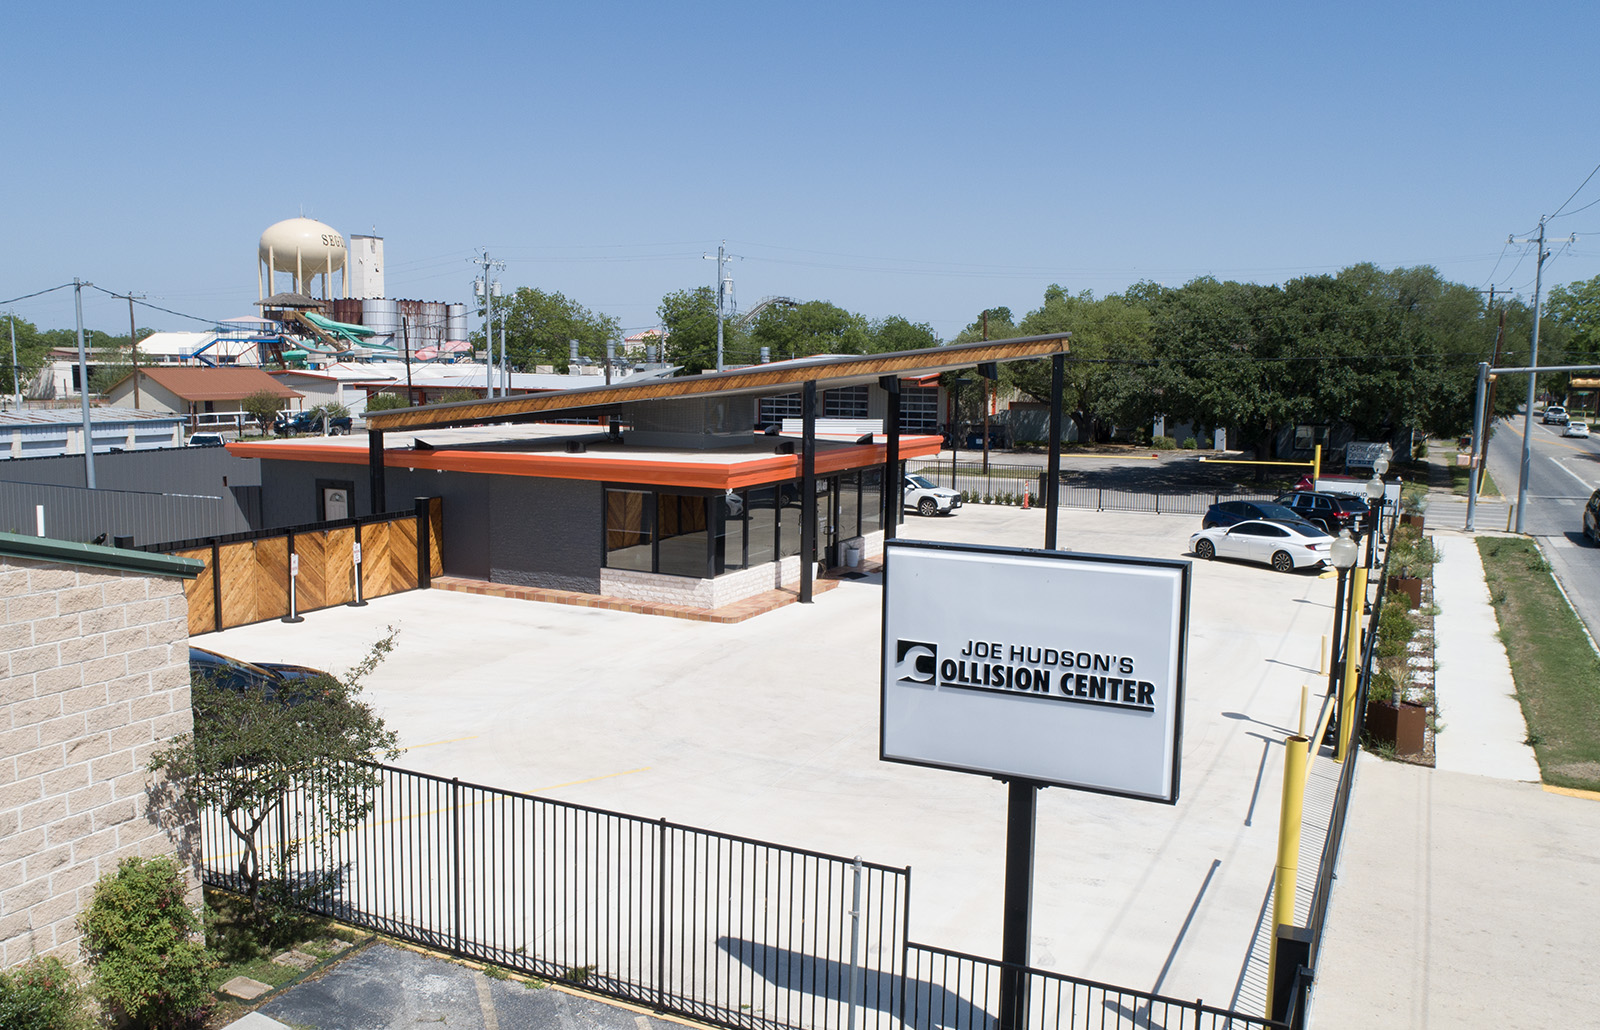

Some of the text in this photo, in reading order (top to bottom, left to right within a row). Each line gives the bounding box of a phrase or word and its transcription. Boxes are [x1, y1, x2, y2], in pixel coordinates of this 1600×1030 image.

[961, 640, 1134, 674] JOE HUDSON'S
[1060, 672, 1155, 704] CENTER
